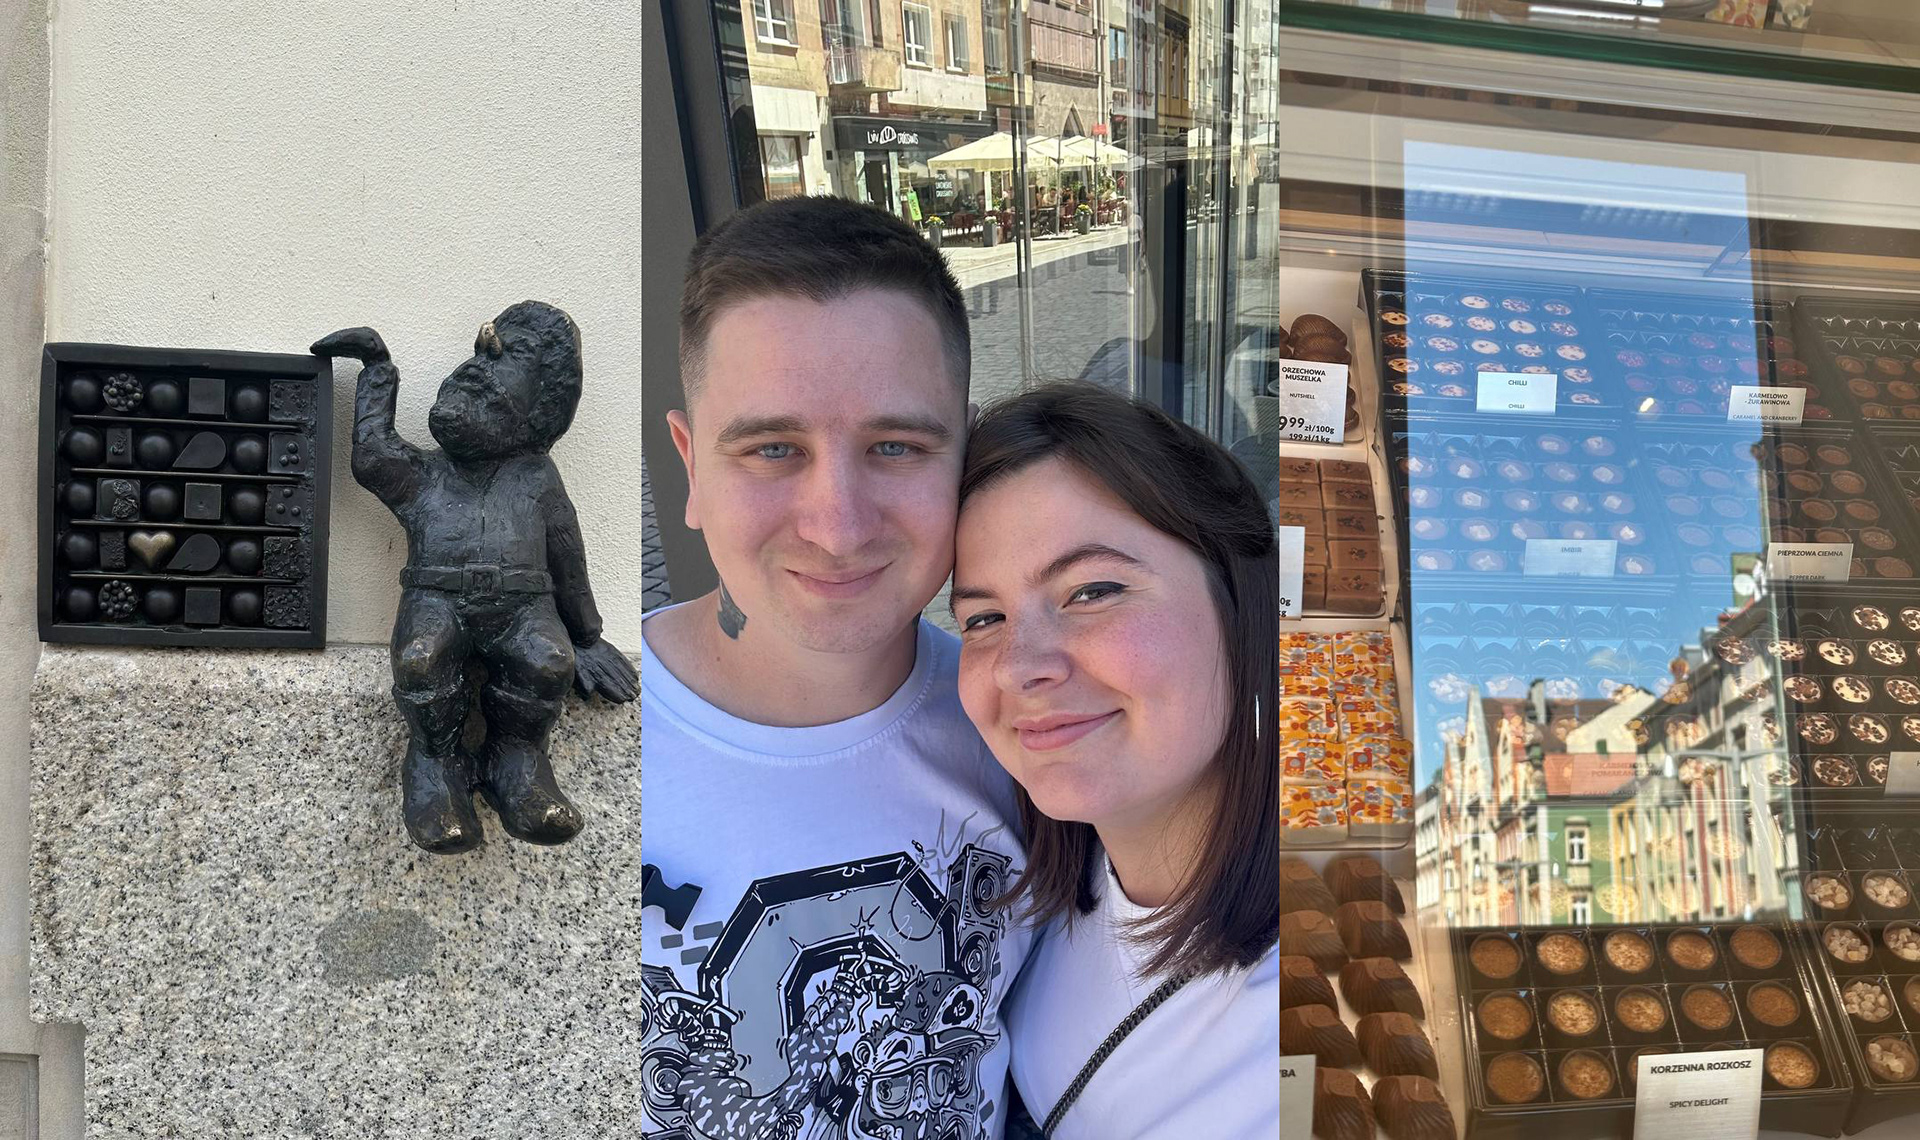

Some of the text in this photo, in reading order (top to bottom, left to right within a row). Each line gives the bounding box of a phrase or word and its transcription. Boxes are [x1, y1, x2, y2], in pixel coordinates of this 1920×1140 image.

[1282, 366, 1326, 376] ORZECHOWA
[1286, 374, 1322, 382] MUSZELKA
[953, 1000, 967, 1017] 13
[1650, 1060, 1752, 1074] KORZENNA ROZKOSZ
[1669, 1098, 1729, 1108] SPICY DELIGHT
